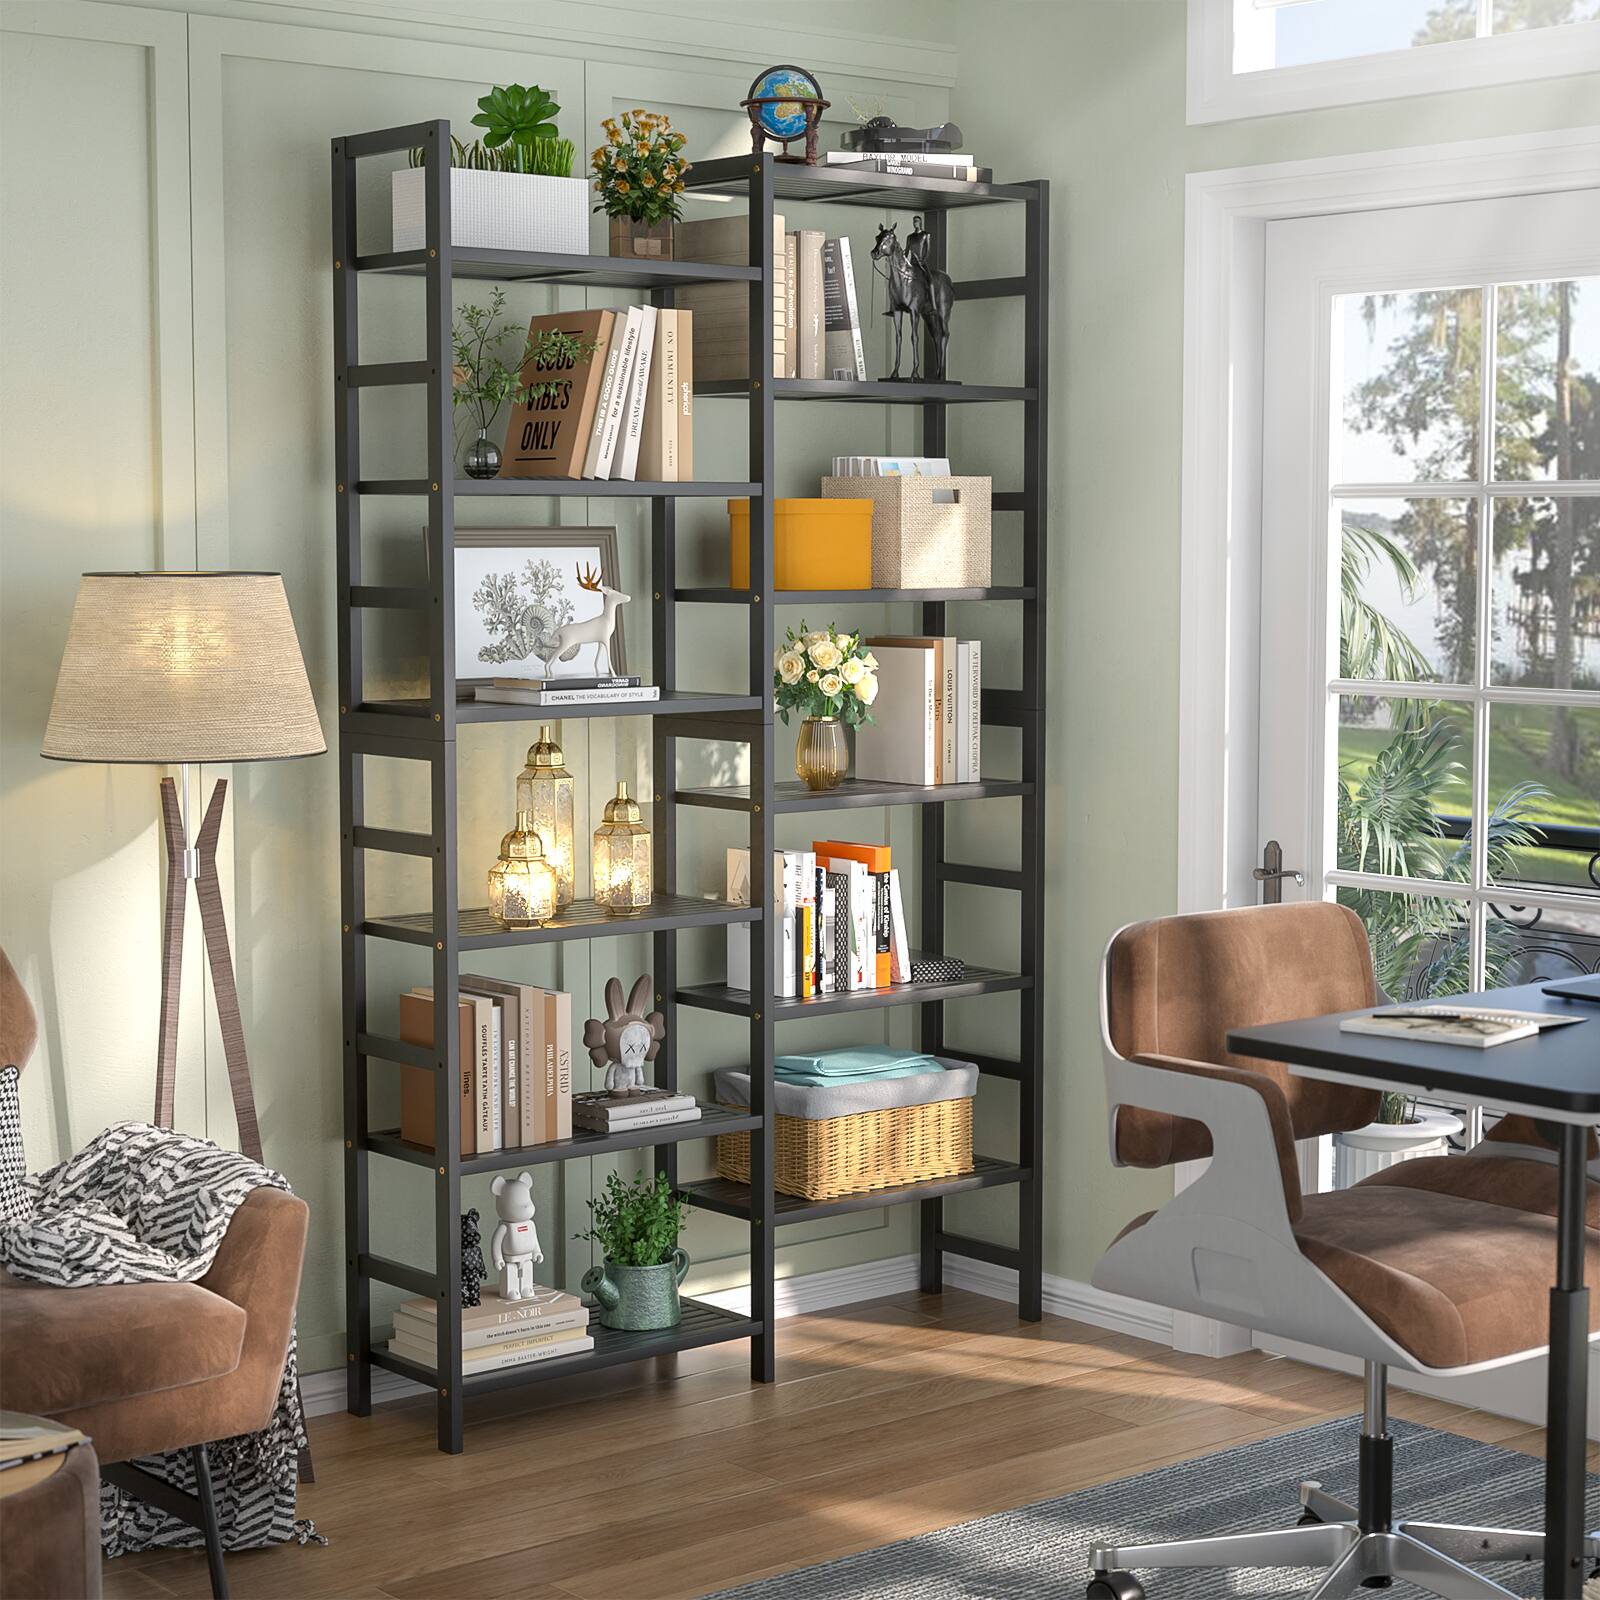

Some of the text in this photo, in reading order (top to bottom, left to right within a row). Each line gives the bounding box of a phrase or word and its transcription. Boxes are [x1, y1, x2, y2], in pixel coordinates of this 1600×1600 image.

[788, 288, 796, 329] Revolution
[666, 331, 674, 345] ON
[604, 375, 612, 400] GOOD
[610, 348, 618, 375] GUIDE
[616, 356, 629, 399] sustainable
[626, 326, 636, 356] lifestyle
[666, 350, 674, 406] IMMUNITY
[528, 380, 573, 412] VIBES
[630, 406, 640, 437] DREAM
[639, 350, 647, 379] AWAKE
[680, 382, 692, 416] spherical
[520, 420, 562, 452] ONLY
[972, 701, 980, 710] BY
[560, 1049, 569, 1094] ASTRID
[503, 1336, 554, 1350] PERFECT IMPERFECT
[517, 1348, 557, 1361] BAXTER-WRIGHT
